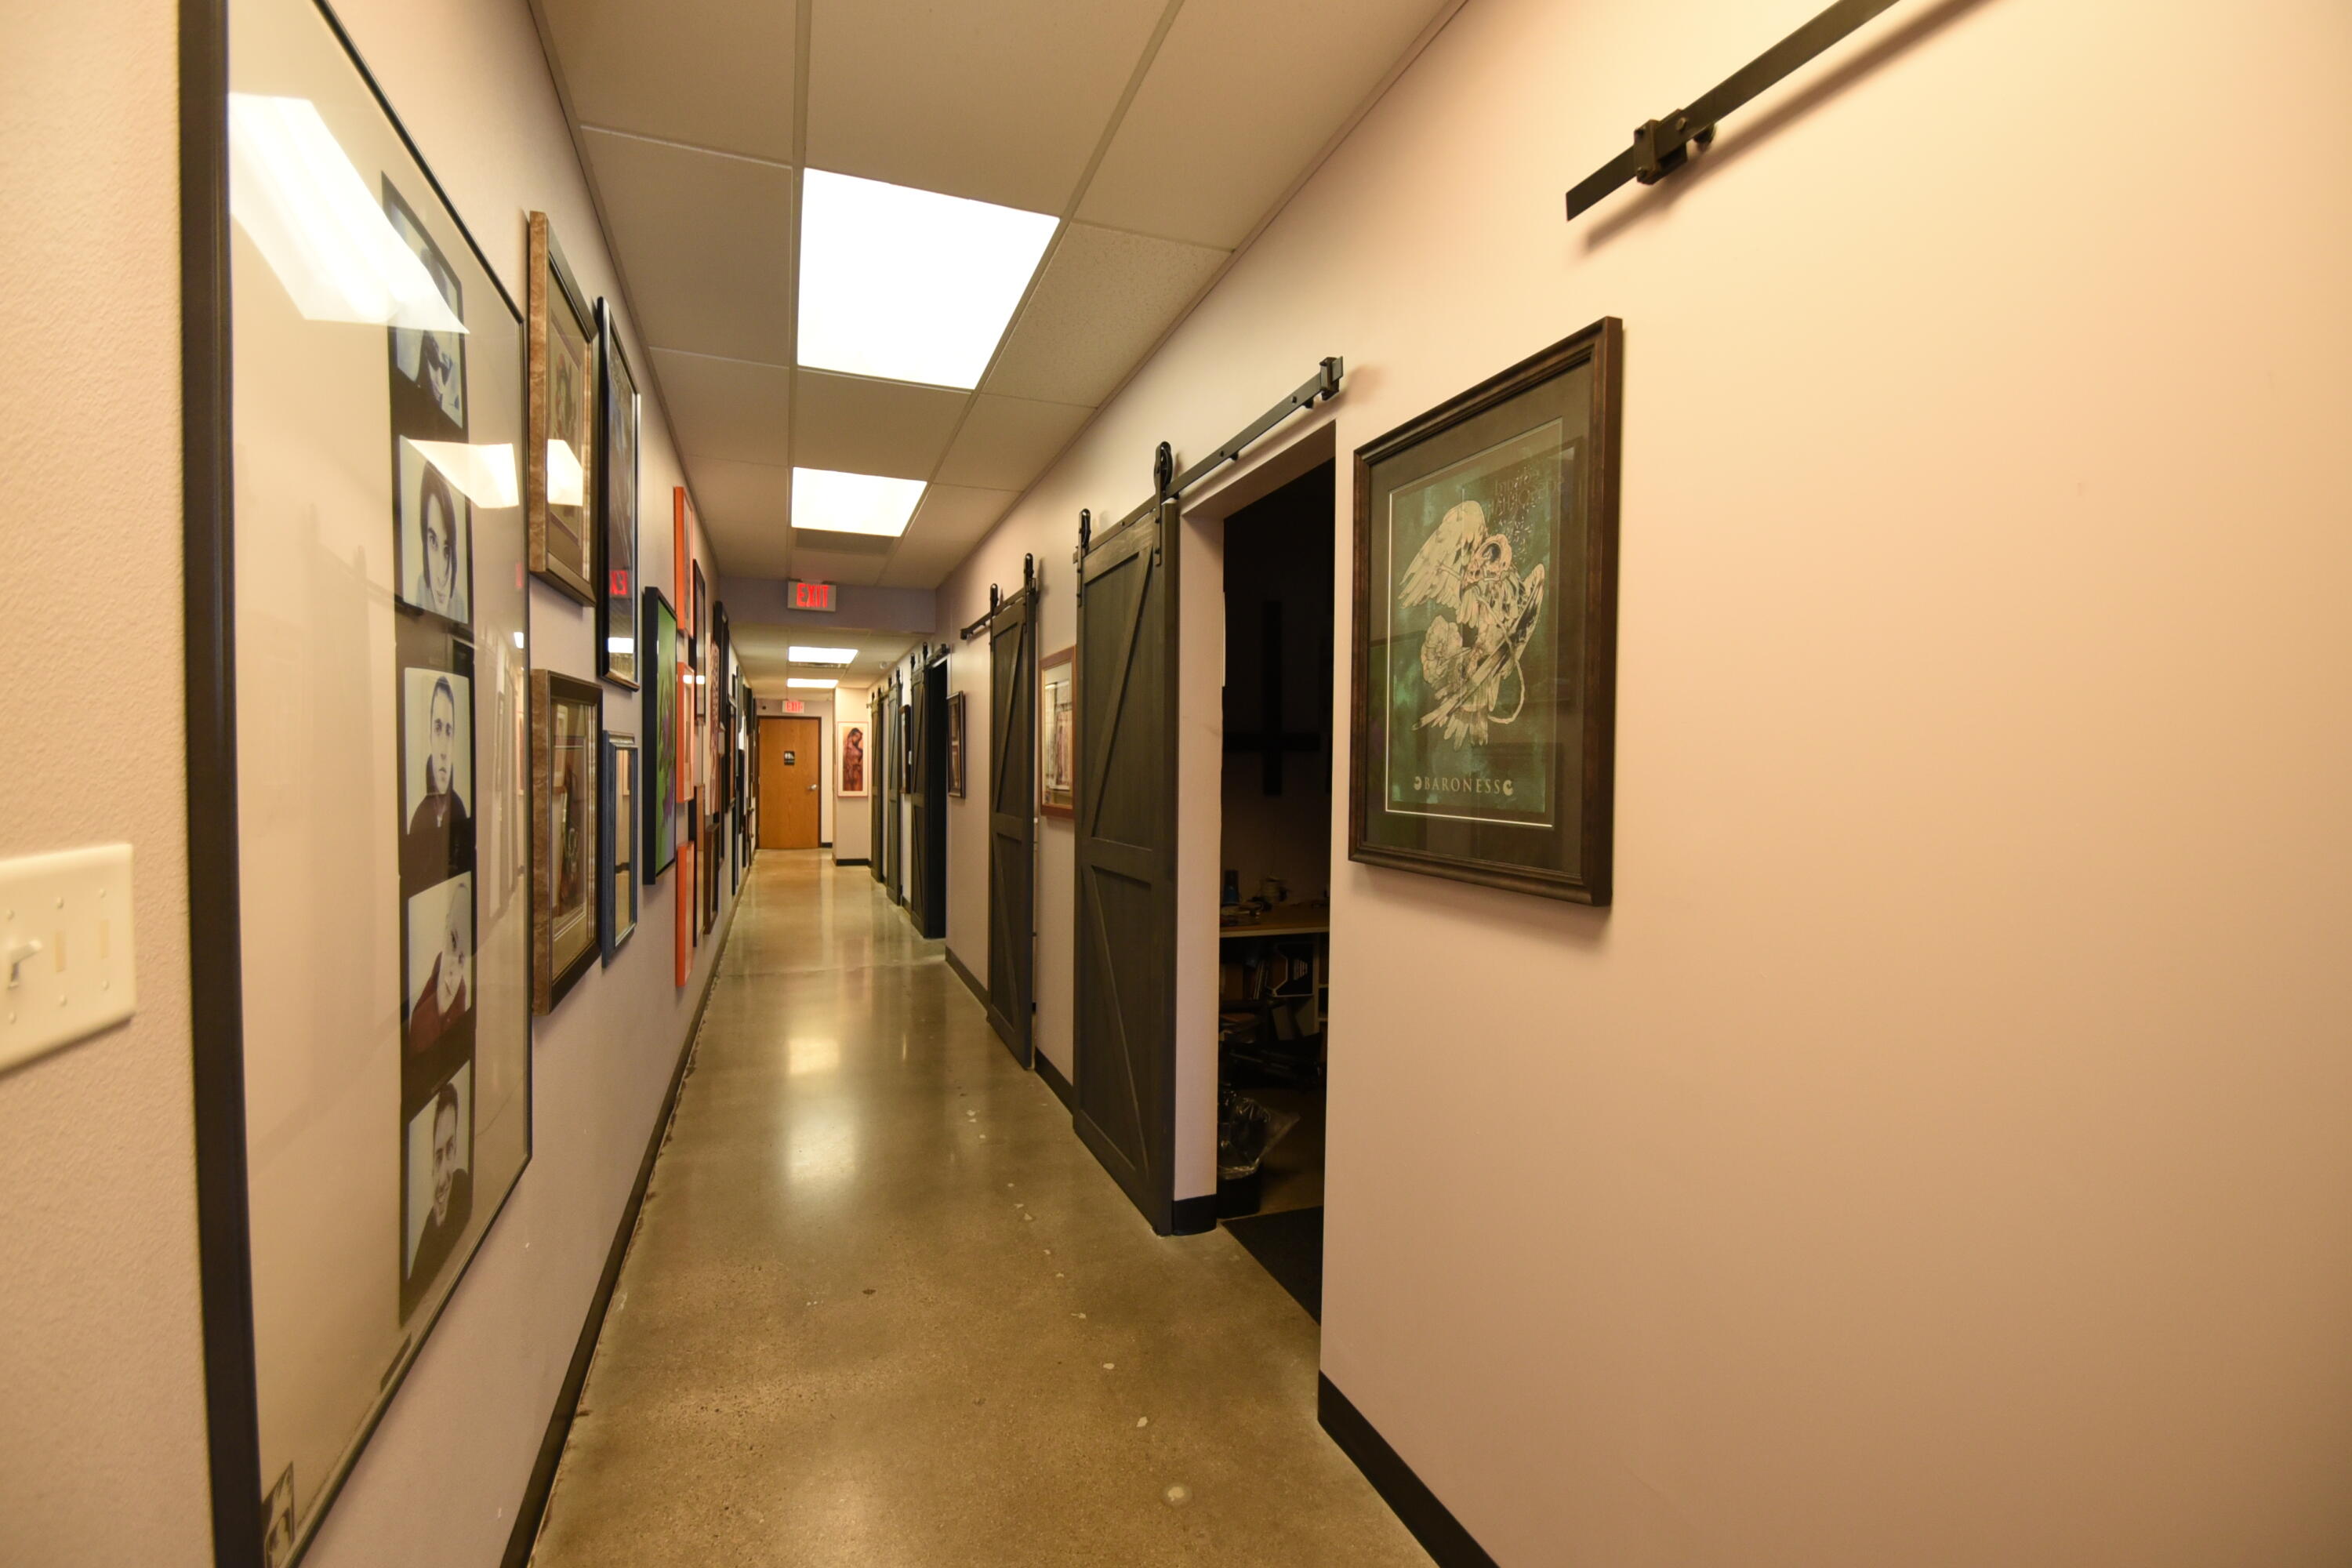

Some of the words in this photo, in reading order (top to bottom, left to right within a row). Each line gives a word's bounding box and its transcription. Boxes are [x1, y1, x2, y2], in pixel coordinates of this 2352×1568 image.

[797, 583, 829, 608] EXIT
[786, 702, 802, 712] EXIT
[1424, 776, 1501, 794] BARONESS
